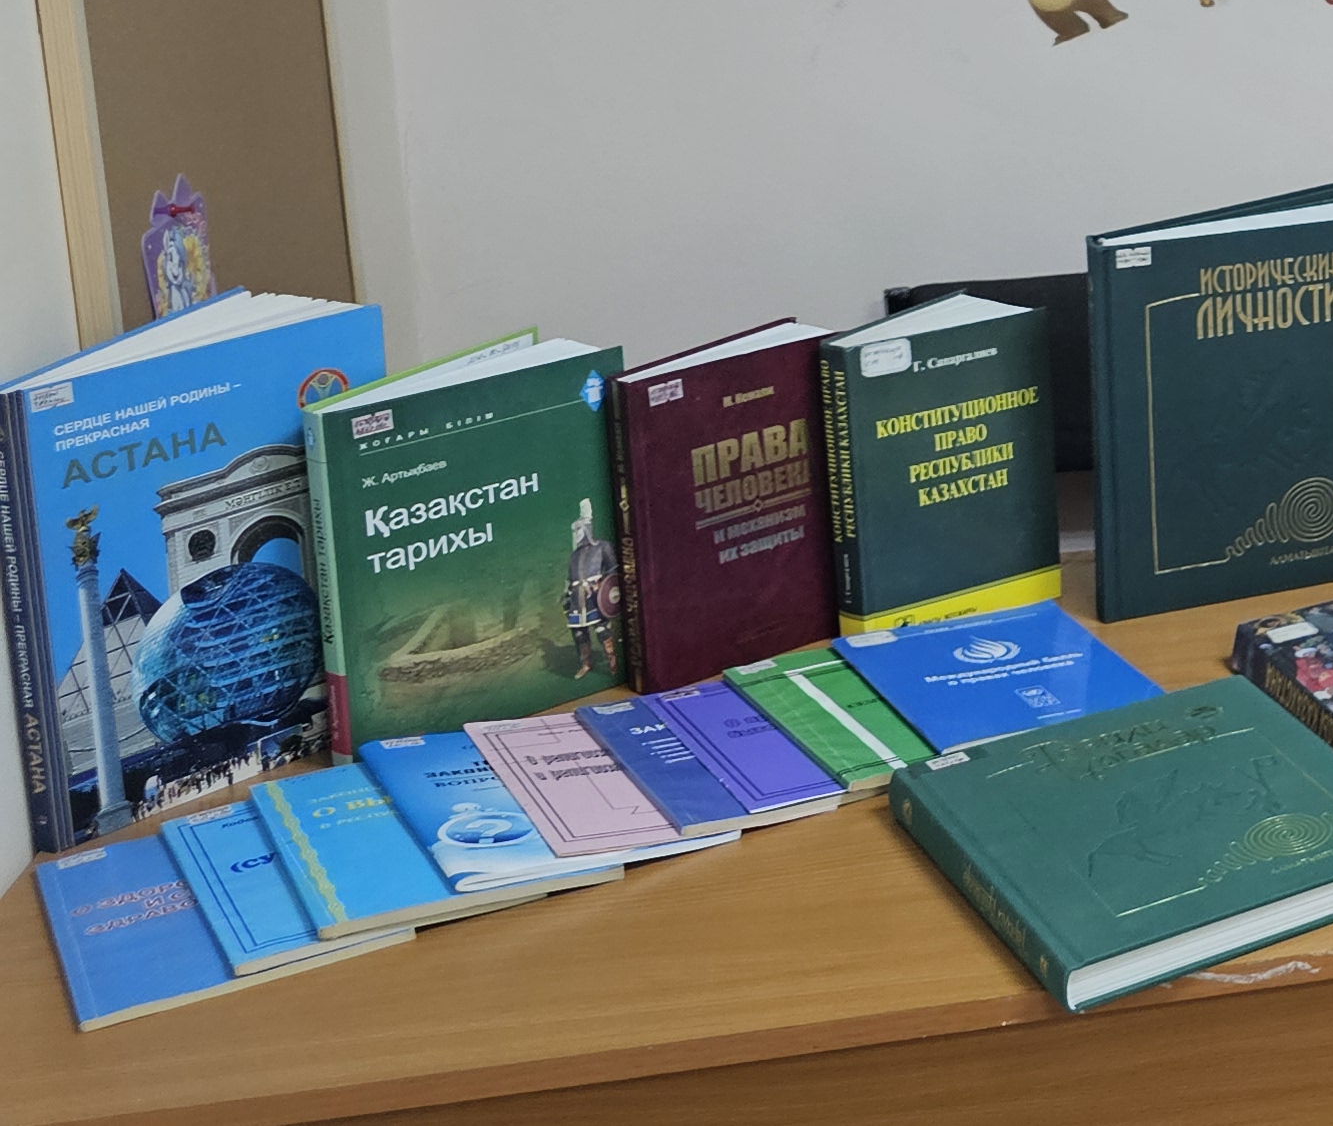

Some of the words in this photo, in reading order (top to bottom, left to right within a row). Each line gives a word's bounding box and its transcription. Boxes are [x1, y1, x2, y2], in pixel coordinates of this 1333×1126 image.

[53, 412, 112, 437] СЕРДЦЕ
[114, 395, 167, 423] НАШЕЙ
[169, 381, 231, 410] РОДИНЫ
[53, 417, 150, 453] ПРЕКРАСНАЯ
[875, 385, 1042, 440] КОНСТИТУЦИОННОЕ
[61, 421, 228, 490] АСТАНА
[690, 417, 811, 488] ПРАВА
[909, 442, 1016, 485] РЕСПУБЛИКИ
[934, 423, 988, 453] ПРАВО
[364, 472, 540, 539] Қазақстан
[917, 467, 1010, 508] КАЗАХСТАН
[366, 522, 495, 574] тарихы
[24, 714, 48, 796] АСТАНА
